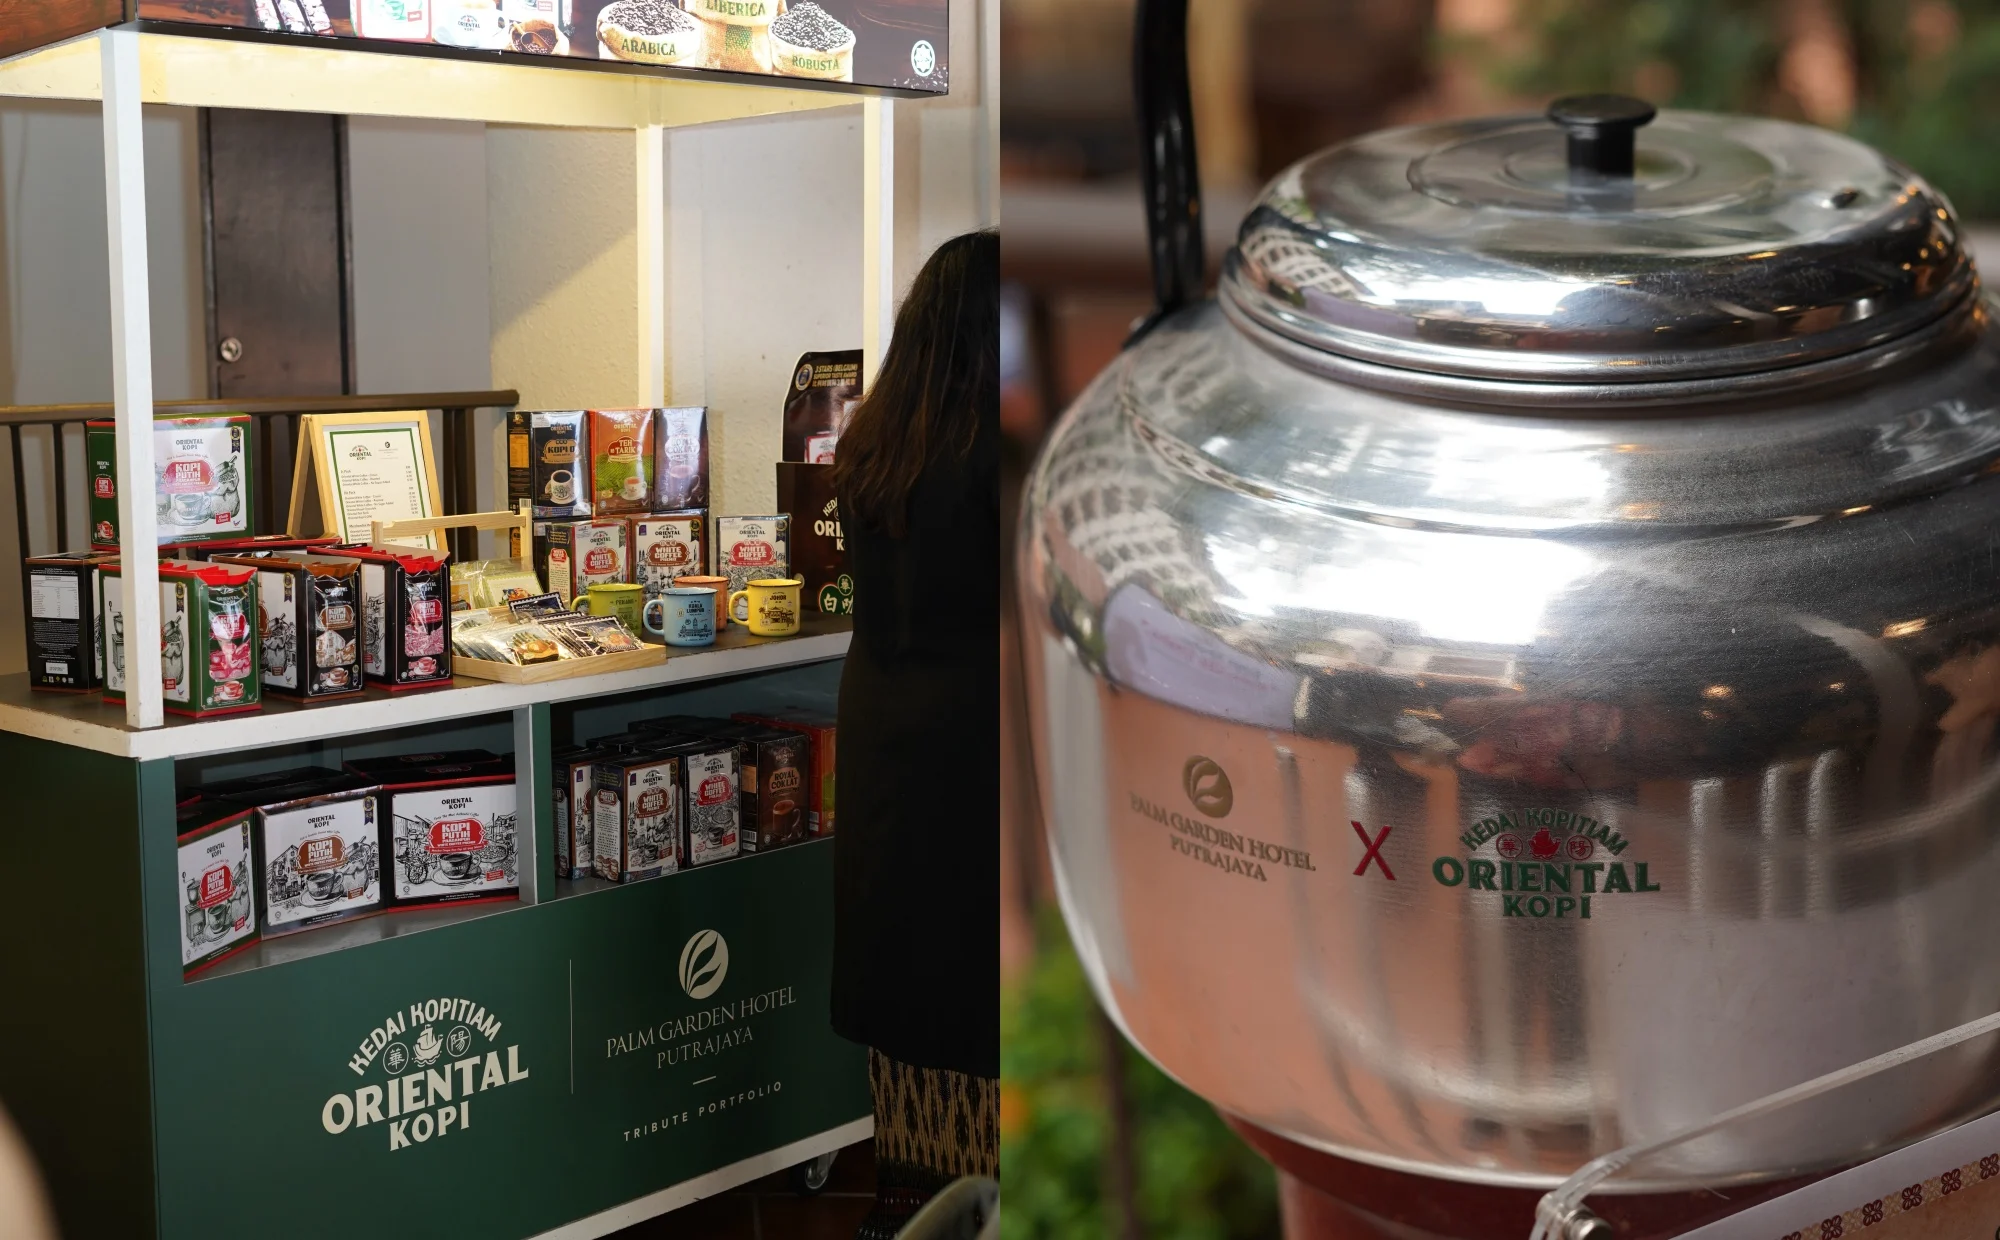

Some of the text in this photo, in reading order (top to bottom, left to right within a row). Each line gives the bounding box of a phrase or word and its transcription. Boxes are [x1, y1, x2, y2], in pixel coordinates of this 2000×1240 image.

[621, 38, 677, 57] ARABICA
[791, 55, 840, 71] ROBUSTA
[547, 446, 569, 454] KOPI
[615, 446, 636, 454] TARIK
[175, 462, 201, 472] KOPI
[814, 520, 844, 537] ORI
[591, 553, 612, 561] WHITE
[704, 763, 725, 772] ORIENTAL
[642, 775, 663, 784] ORIENTAL
[774, 769, 796, 781] ROYAL
[705, 781, 726, 790] WHITE
[771, 777, 798, 790] COKLAT
[642, 793, 664, 803] WHITE
[704, 787, 727, 797] COFFEE
[441, 797, 473, 805] ORIENTAL
[642, 800, 664, 809] COFFEE
[308, 814, 336, 824] ORIENTAL
[442, 822, 471, 833] KOPI
[1129, 791, 1317, 872] PALM GARDEN HOTEL
[1459, 807, 1629, 856] KEDAI KOPITIAM
[442, 831, 471, 840] PUTIH
[206, 842, 225, 854] ORIENTAL
[308, 840, 333, 853] KOPI
[1351, 820, 1397, 881] X
[308, 848, 333, 859] PUTIH
[1169, 834, 1268, 882] PUTRAJAYA
[207, 869, 225, 884] KOPI
[1432, 856, 1661, 894] ORIENTAL
[207, 878, 225, 892] PUTIH
[1502, 893, 1592, 919] KOPI
[606, 986, 797, 1058] PALM GARDEN HOTEL
[348, 998, 502, 1077] KEDAI KOPITIAM
[657, 1026, 754, 1069] PUTRAJAYA
[322, 1044, 529, 1135] ORIENTAL
[623, 1081, 783, 1142] TRIBUTE PORTFOLIO
[389, 1100, 470, 1151] KOPI
